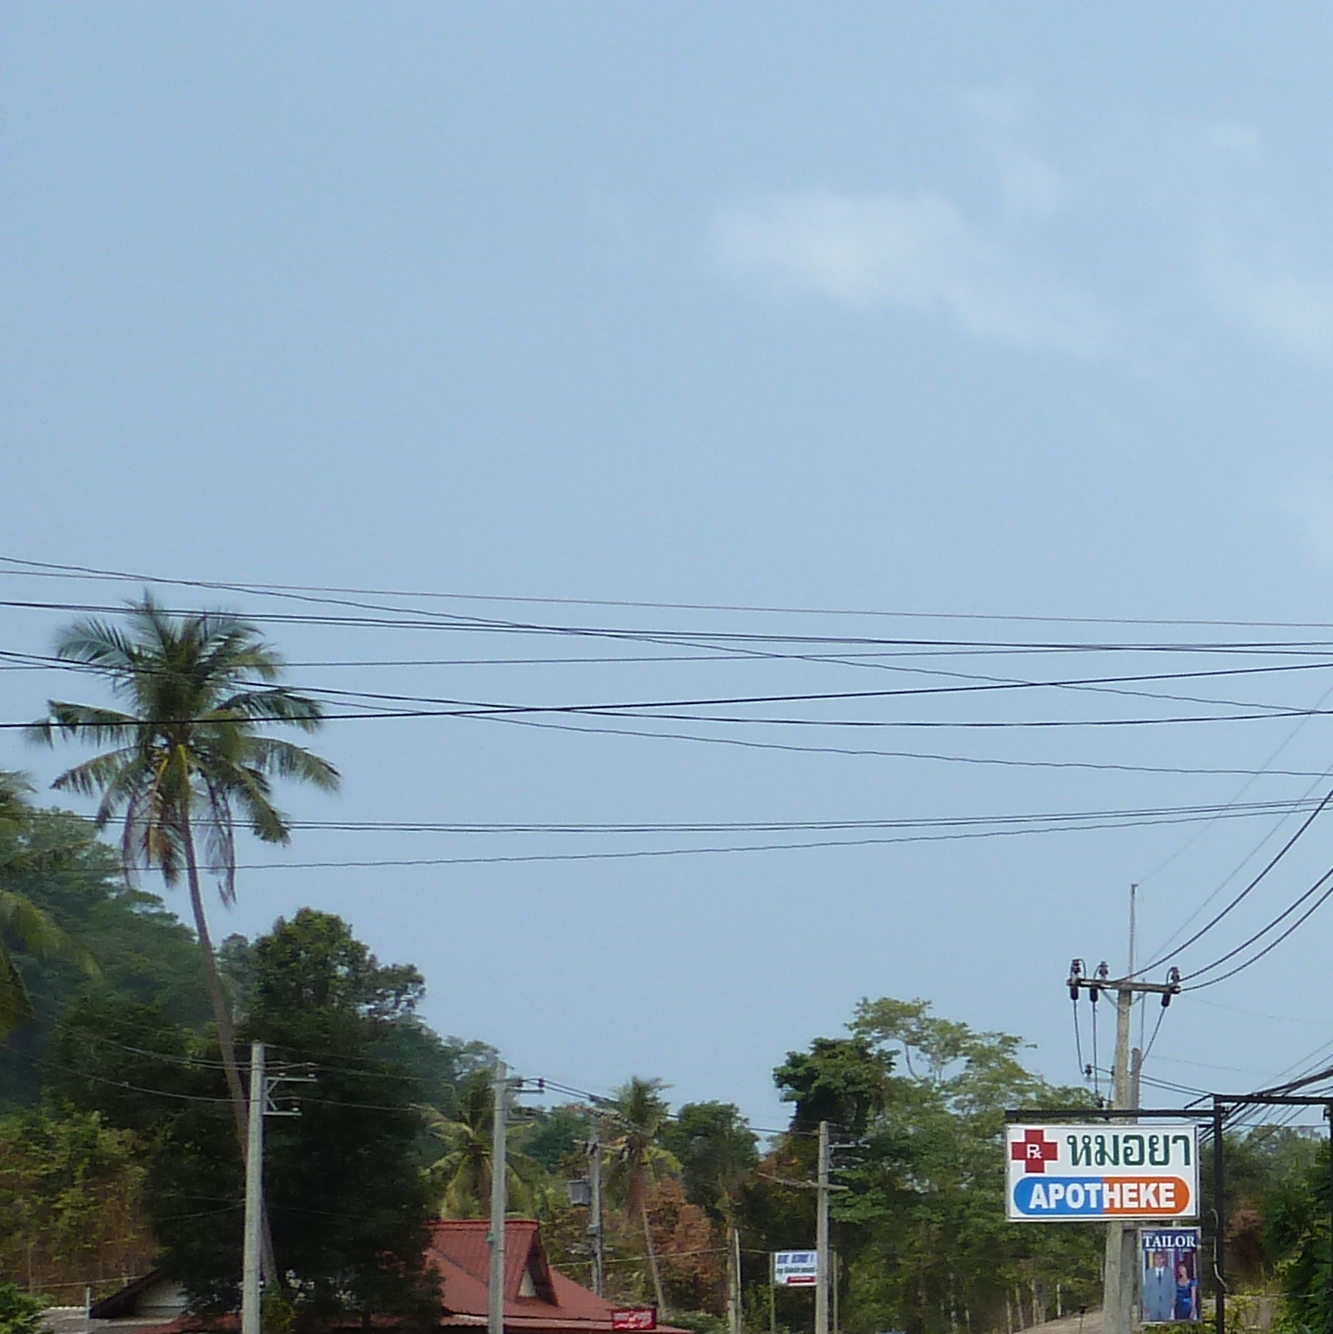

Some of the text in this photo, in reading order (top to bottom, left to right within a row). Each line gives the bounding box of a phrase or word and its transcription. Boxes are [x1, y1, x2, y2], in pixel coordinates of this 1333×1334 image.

[1066, 1134, 1191, 1166] หมอยา
[1029, 1182, 1176, 1210] APOTHEKE
[1143, 1235, 1197, 1248] TAILOR
